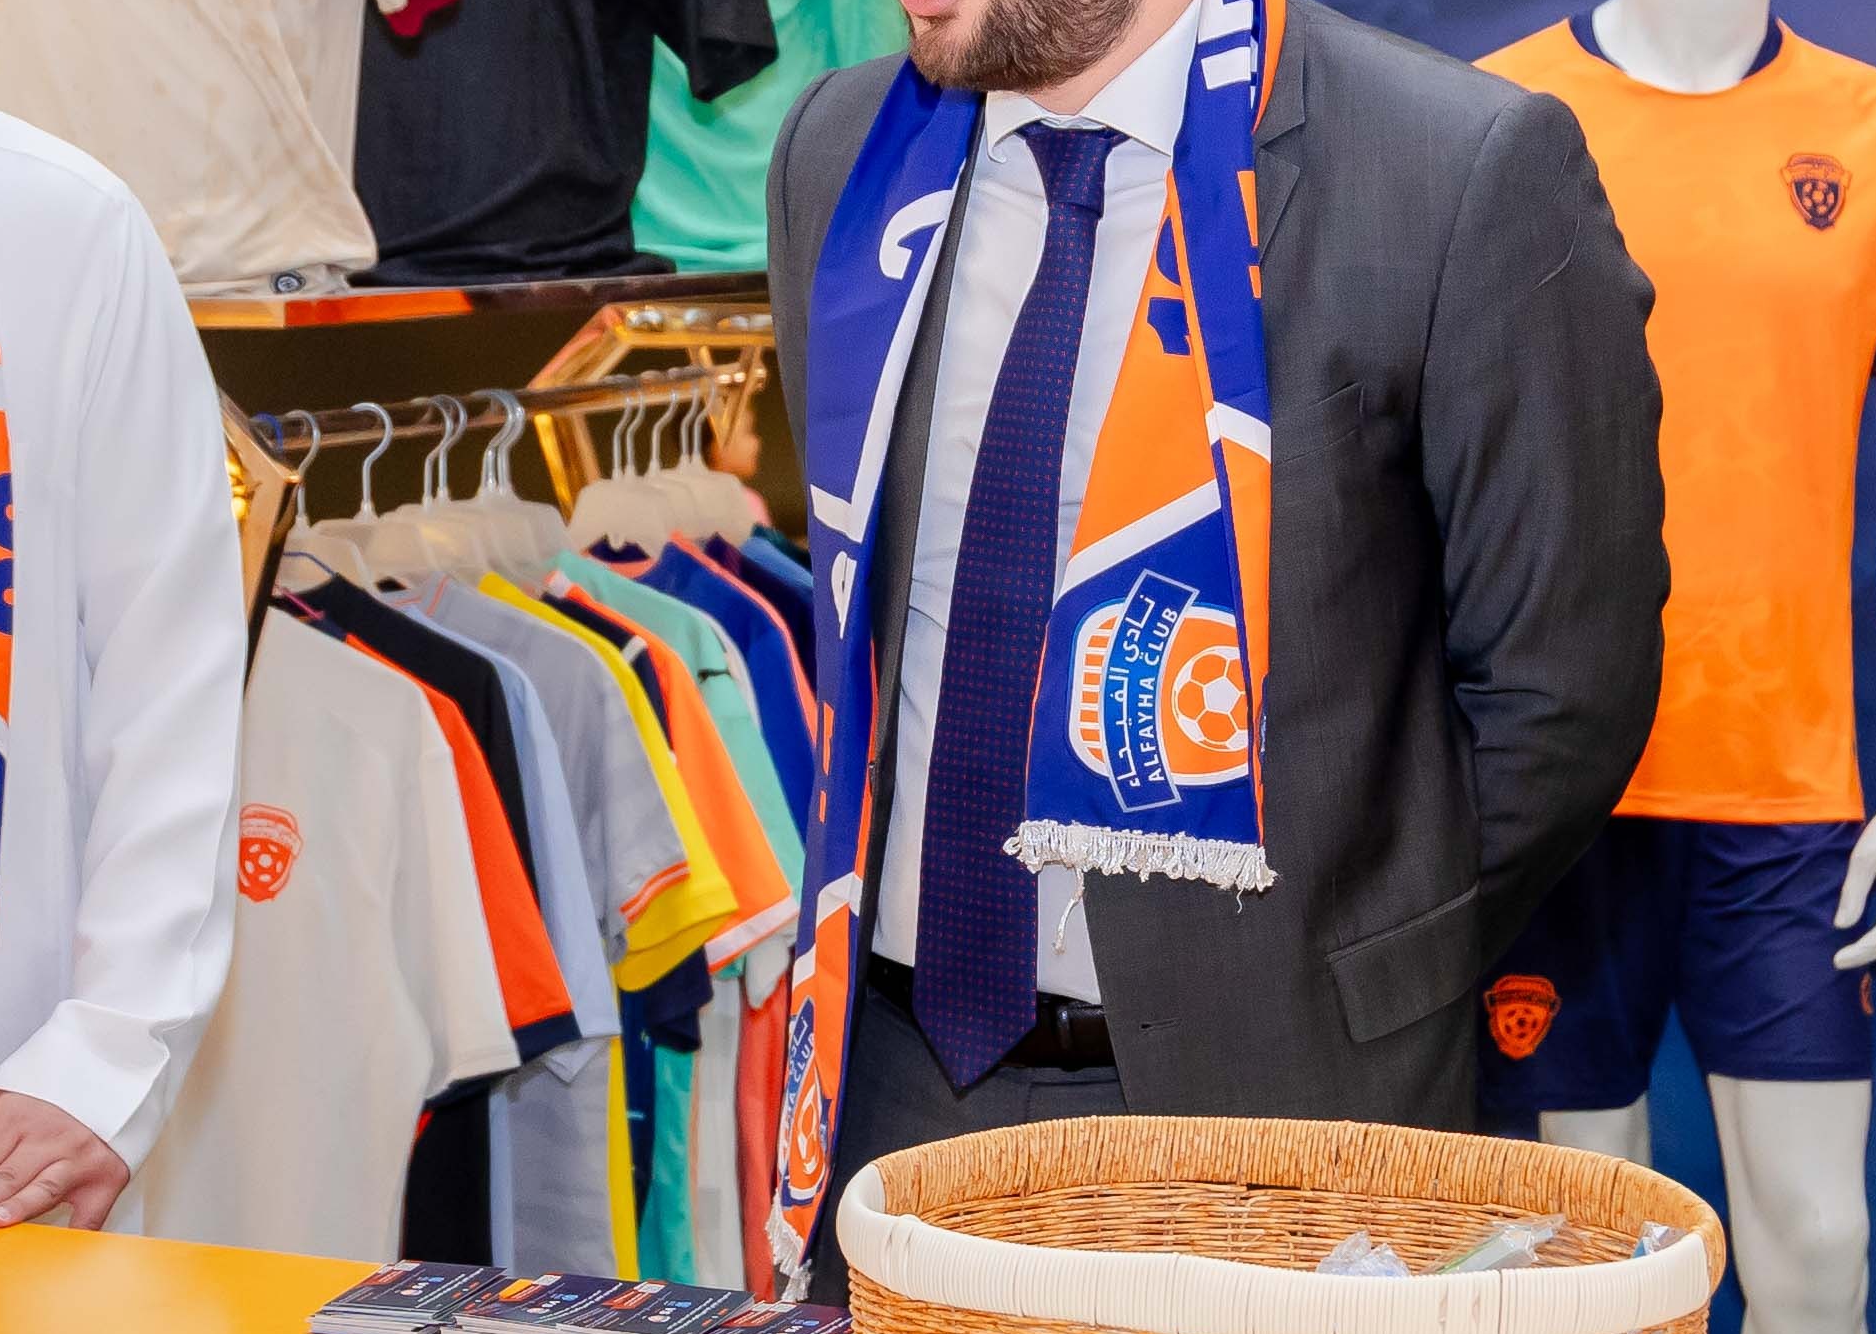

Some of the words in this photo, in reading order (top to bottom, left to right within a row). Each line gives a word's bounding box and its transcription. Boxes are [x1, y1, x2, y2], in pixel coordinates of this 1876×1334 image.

[1123, 594, 1155, 663] نادي
[1145, 607, 1178, 666] CLUB
[1108, 667, 1141, 787] الفيحاء
[1138, 677, 1165, 782] ALFAYHA
